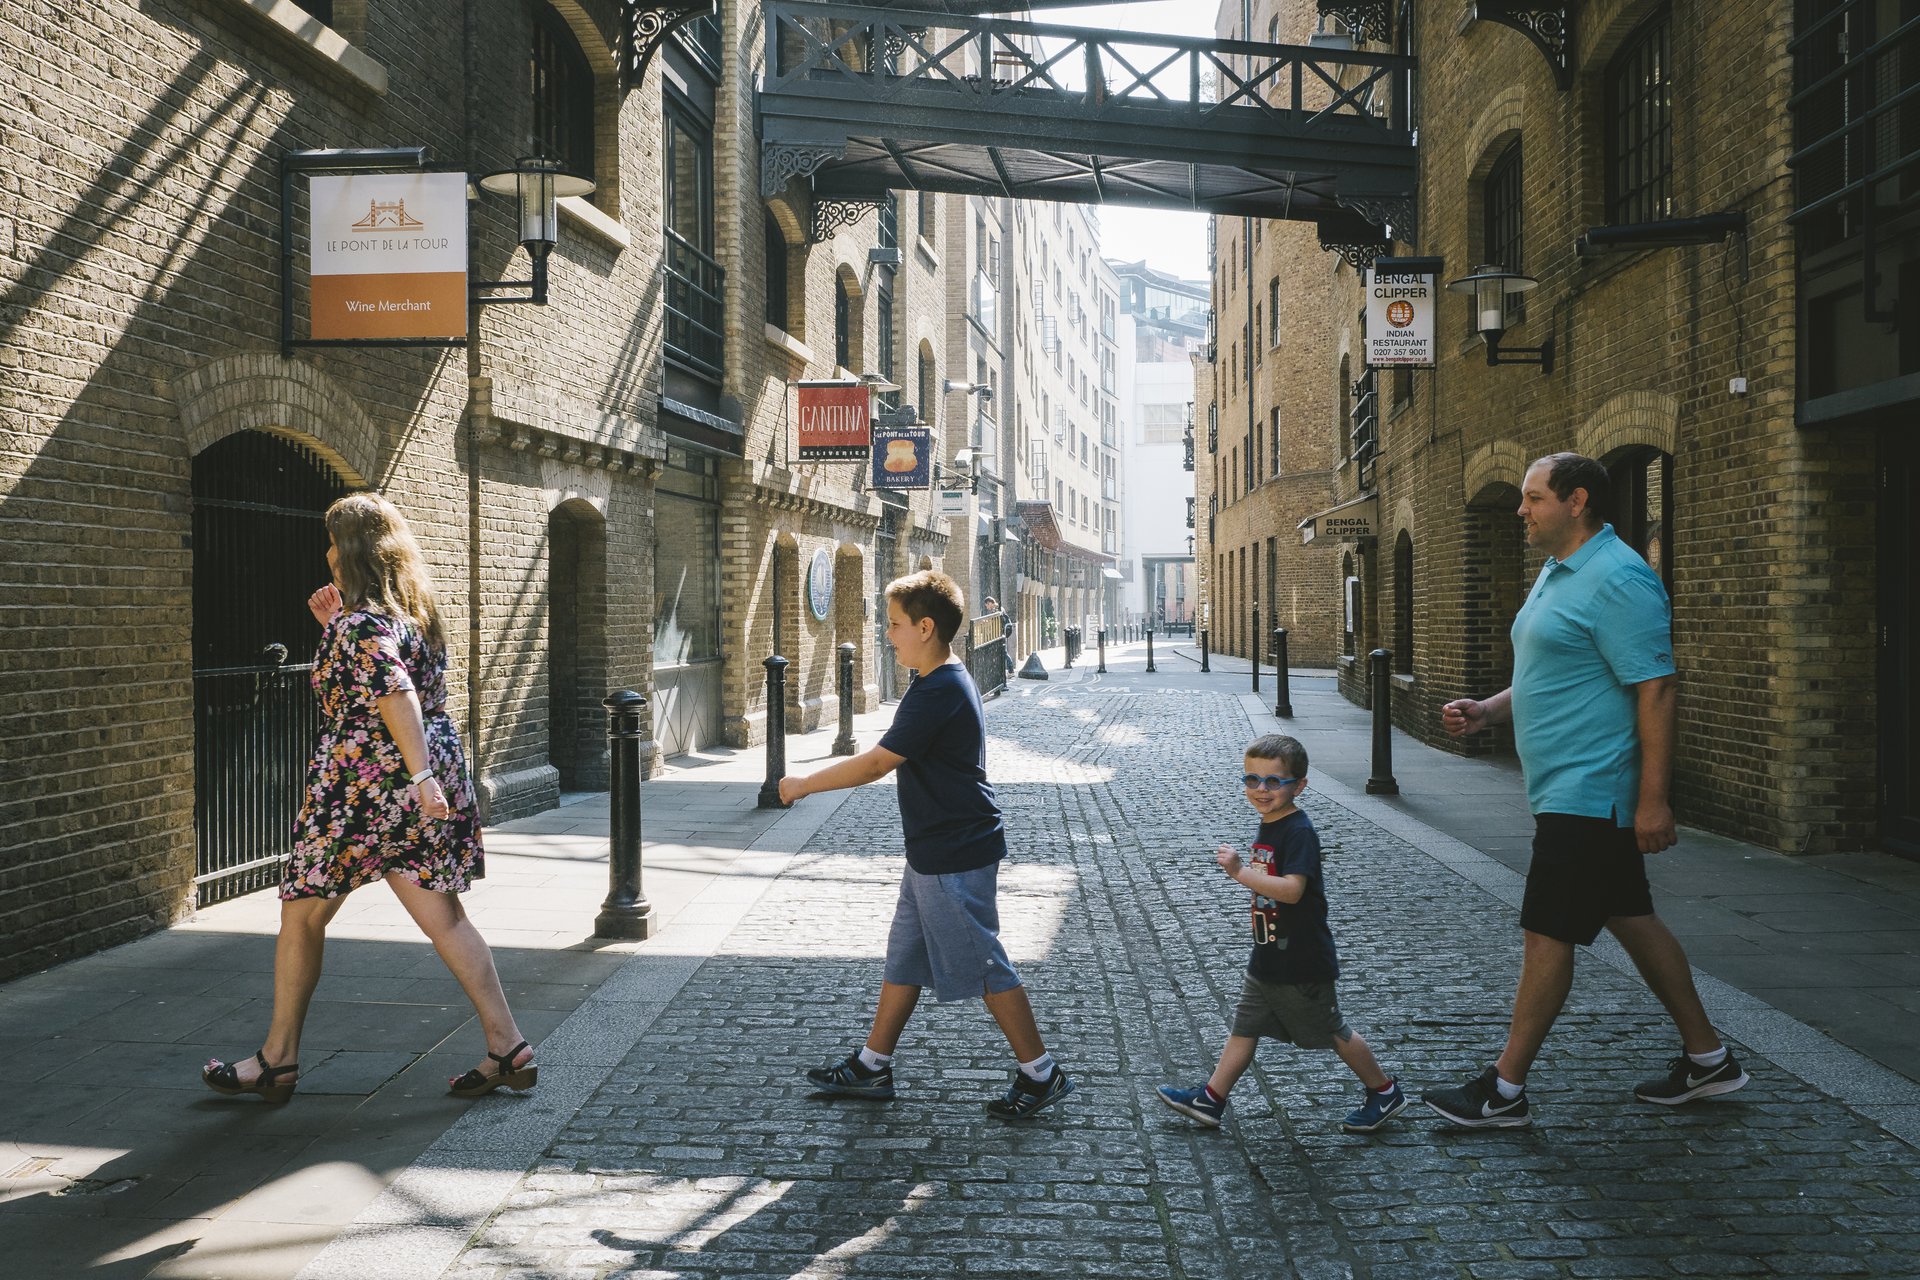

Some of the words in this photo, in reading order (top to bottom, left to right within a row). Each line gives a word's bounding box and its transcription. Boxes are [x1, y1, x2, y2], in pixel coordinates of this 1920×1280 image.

[327, 241, 337, 252] LE
[341, 239, 378, 252] PONT
[382, 239, 393, 251] DE
[397, 239, 409, 250] LA
[413, 238, 449, 250] TOUR
[1374, 273, 1427, 285] BENGAL
[1374, 287, 1427, 299] CLIPPER
[345, 300, 376, 312] Wine
[378, 299, 431, 312] Merchant
[1386, 330, 1415, 338] INDIAN
[1372, 339, 1428, 347] RESTAURANT
[1373, 348, 1391, 356] 0207
[1393, 348, 1407, 356] 357
[1409, 348, 1427, 356] 9001
[801, 405, 866, 432] CANTINA
[910, 430, 926, 438] TOUR
[1326, 518, 1370, 526] BENGAL
[1326, 527, 1370, 535] CLIPPER
